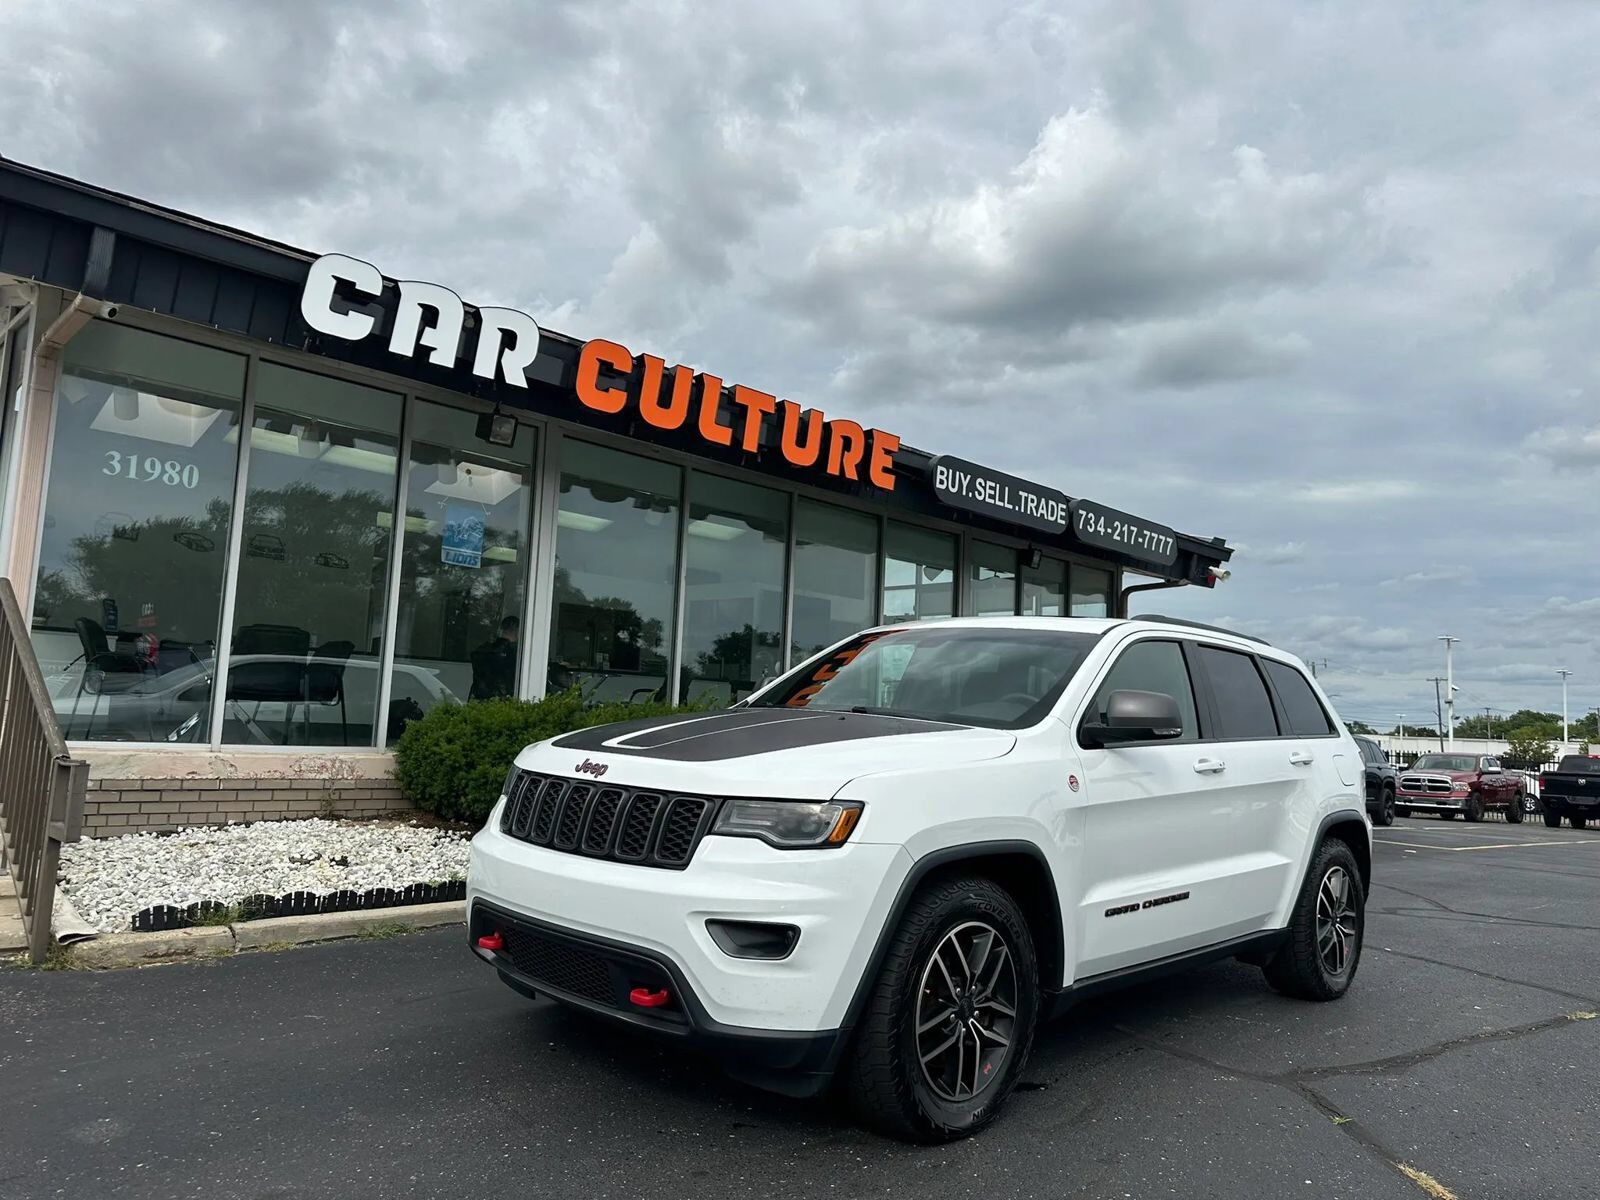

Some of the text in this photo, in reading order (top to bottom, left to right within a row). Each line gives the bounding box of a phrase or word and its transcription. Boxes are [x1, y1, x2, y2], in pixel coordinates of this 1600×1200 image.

[300, 253, 901, 492] CAR CULTURE
[102, 450, 200, 489] 31980
[1078, 509, 1174, 556] 734-217-7777
[575, 757, 609, 779] Jeep
